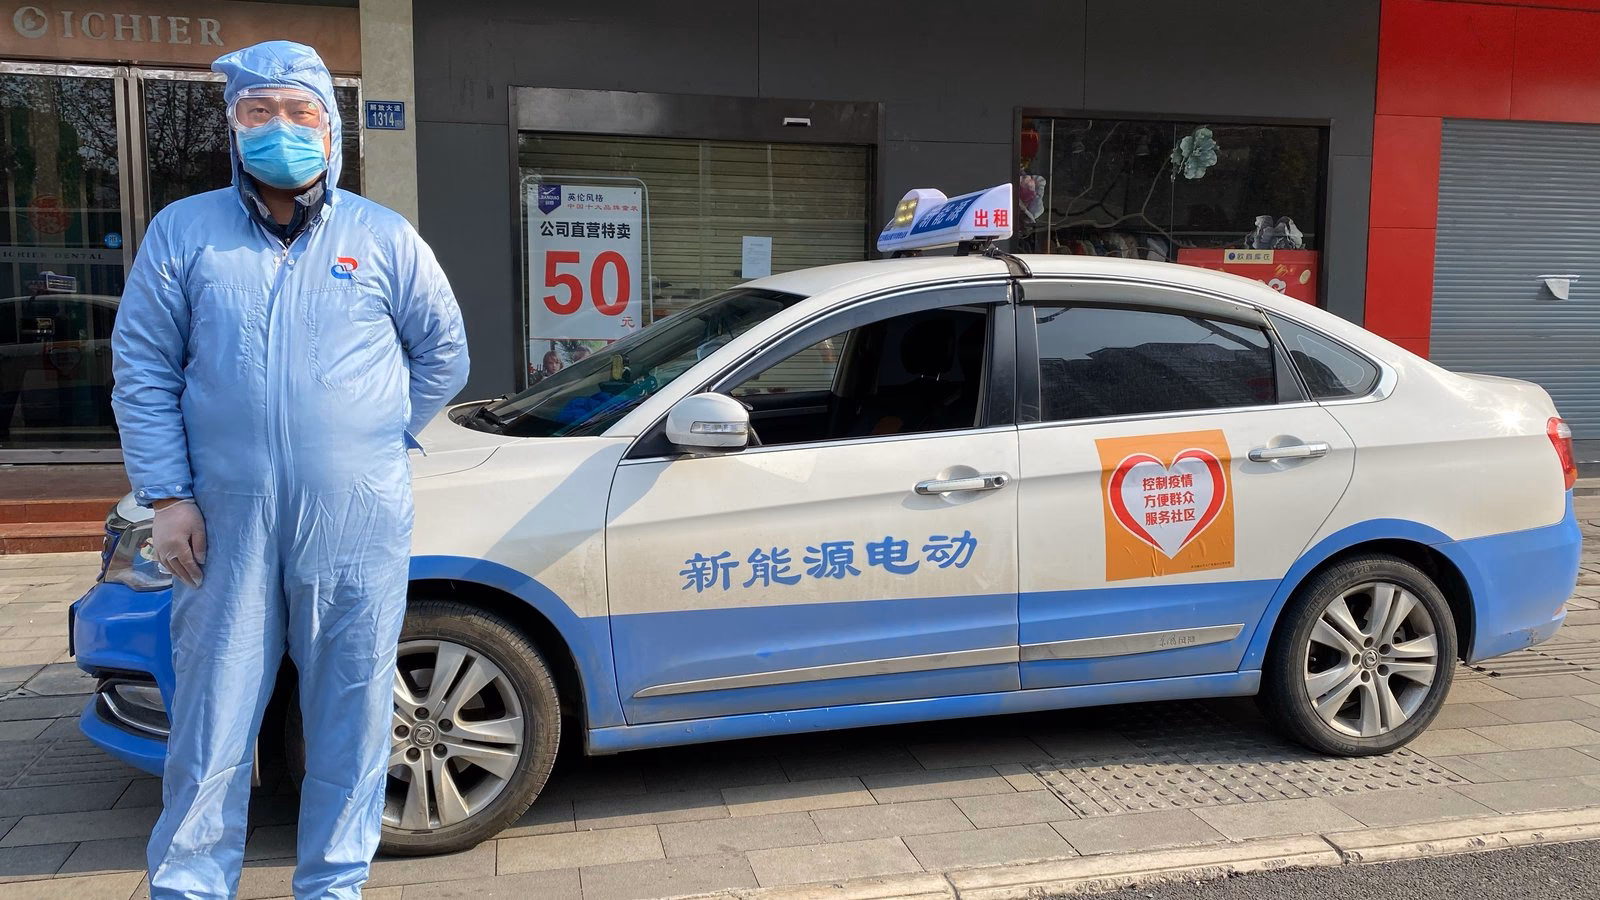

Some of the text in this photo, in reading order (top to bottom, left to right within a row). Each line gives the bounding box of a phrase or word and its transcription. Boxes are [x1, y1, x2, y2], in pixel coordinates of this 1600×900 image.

[61, 10, 225, 47] ICHIER
[370, 104, 400, 112] 解放大道
[373, 111, 395, 126] 1314
[567, 192, 604, 202] 英伦风格
[974, 209, 1008, 228] 出租
[540, 220, 631, 239] 公司直营特卖
[543, 250, 631, 316] 50
[620, 317, 635, 328] 元
[1142, 474, 1193, 492] 控制疫情
[1144, 491, 1195, 508] 方便群众
[1145, 508, 1196, 526] 服务社区
[679, 529, 978, 594] 新能源电动
[1352, 565, 1371, 576] 228
